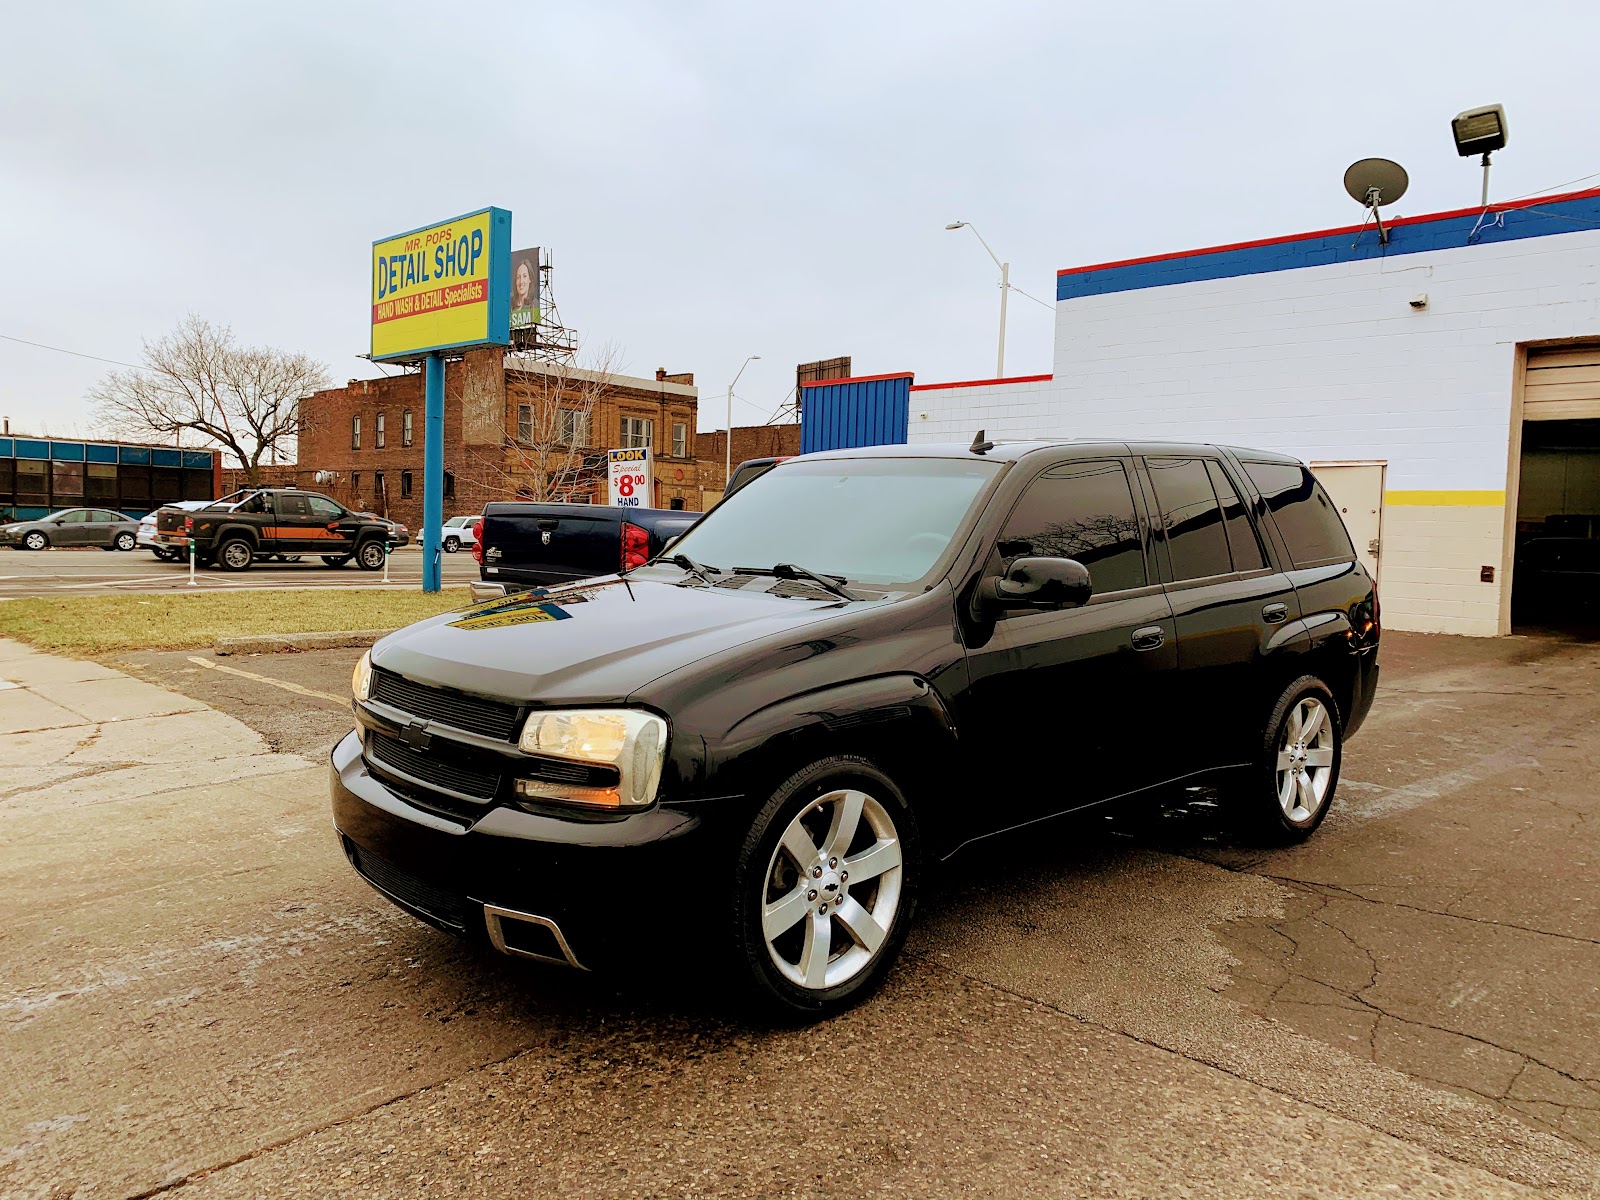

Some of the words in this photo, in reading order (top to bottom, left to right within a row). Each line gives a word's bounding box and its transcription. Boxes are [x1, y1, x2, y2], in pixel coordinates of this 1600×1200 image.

[404, 239, 423, 253] MR.
[425, 228, 452, 247] POPS
[379, 252, 429, 299] DETAIL
[434, 229, 482, 279] SHOP
[377, 304, 394, 320] HAND
[395, 298, 414, 316] WASH
[414, 296, 421, 311] &
[421, 290, 444, 310] DETAIL
[444, 283, 482, 306] Specialists
[610, 450, 644, 462] LOOK
[612, 463, 642, 474] Special
[617, 497, 639, 507] HAND
